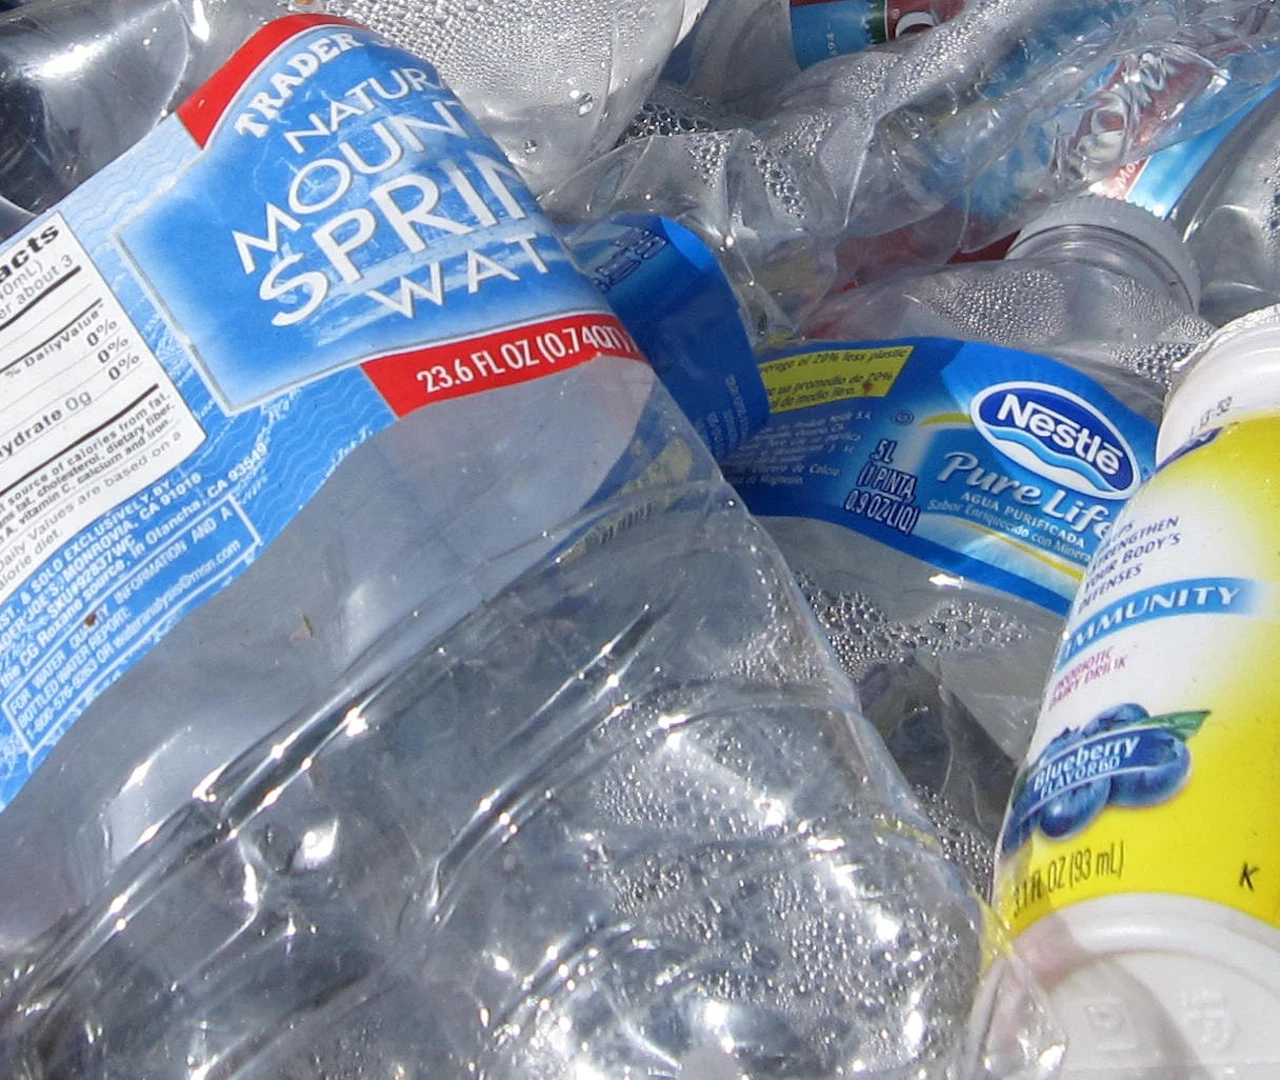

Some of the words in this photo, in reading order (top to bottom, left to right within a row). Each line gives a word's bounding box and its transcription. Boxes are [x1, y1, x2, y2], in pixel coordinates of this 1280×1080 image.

[233, 30, 367, 139] TRADER
[16, 266, 61, 306] about
[367, 232, 550, 320] WAT
[86, 320, 118, 348] 0%
[97, 337, 130, 365] 0%
[417, 357, 476, 394] 23.6
[476, 349, 508, 377] FL
[504, 337, 540, 369] OZ
[535, 325, 638, 362] (0.74QT)
[108, 353, 141, 382] 0%
[996, 394, 1124, 477] Nestlé
[8, 473, 49, 507] source
[66, 431, 118, 466] calories
[875, 466, 919, 502] PINTA,
[936, 450, 1041, 505] Pure
[18, 497, 61, 525] vitamin
[27, 503, 74, 541] Values
[104, 456, 149, 488] based
[926, 497, 964, 515] Sabor
[1028, 530, 1053, 549] con
[961, 490, 1002, 513] AGUA
[1004, 505, 1087, 549] PURIFICADA
[30, 559, 64, 595] SOLD
[63, 493, 153, 559] EXCLUSIVELY
[1120, 533, 1182, 570] BODY'S
[113, 539, 189, 606] INFORMATION
[1033, 737, 1140, 793] Blueberry
[1047, 863, 1066, 890] OZ
[1068, 852, 1093, 889] (93
[1095, 842, 1125, 877] mL)
[1238, 863, 1260, 891] K
